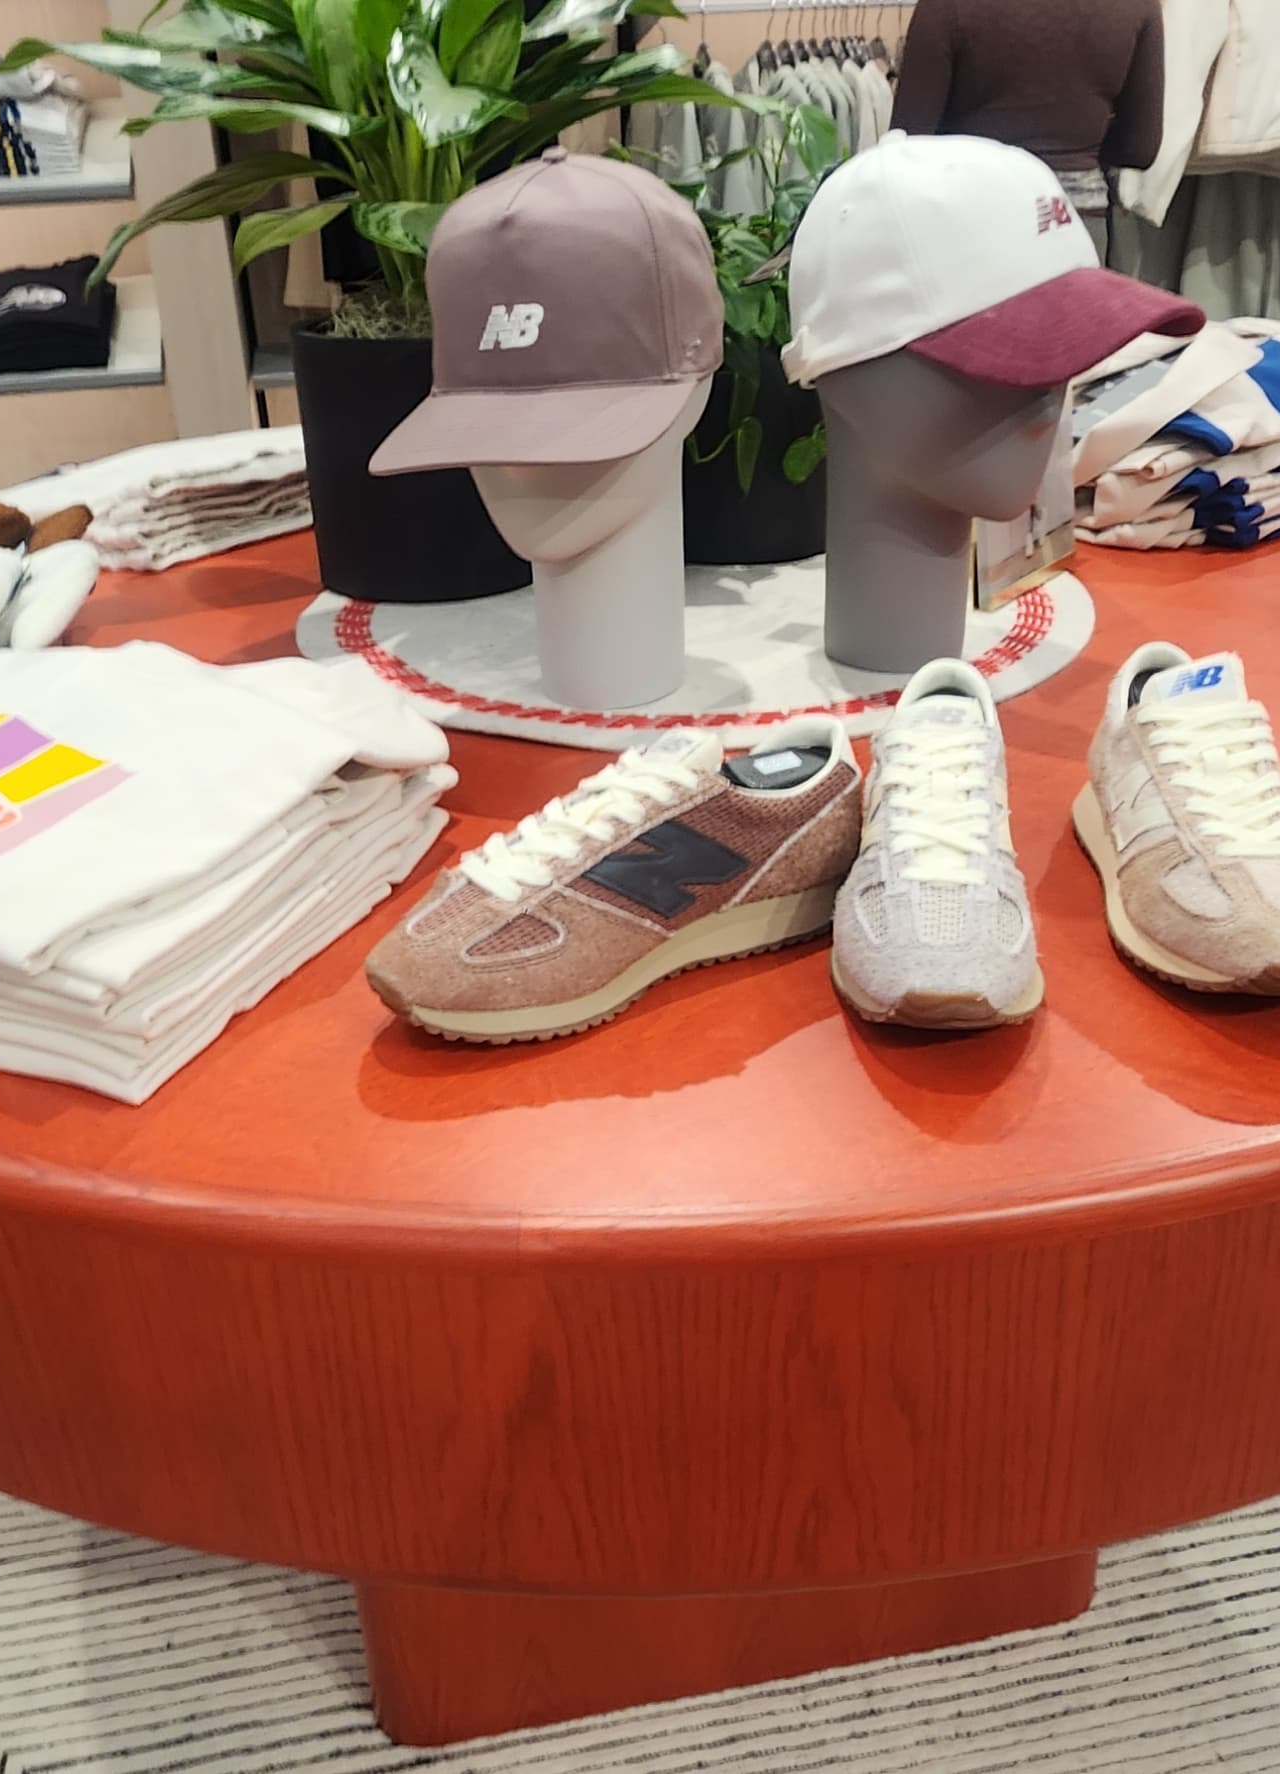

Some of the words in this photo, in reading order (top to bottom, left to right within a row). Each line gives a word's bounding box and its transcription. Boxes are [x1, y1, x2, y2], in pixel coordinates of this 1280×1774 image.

[479, 303, 544, 351] NB
[1168, 665, 1224, 698] NB
[581, 819, 751, 919] N
